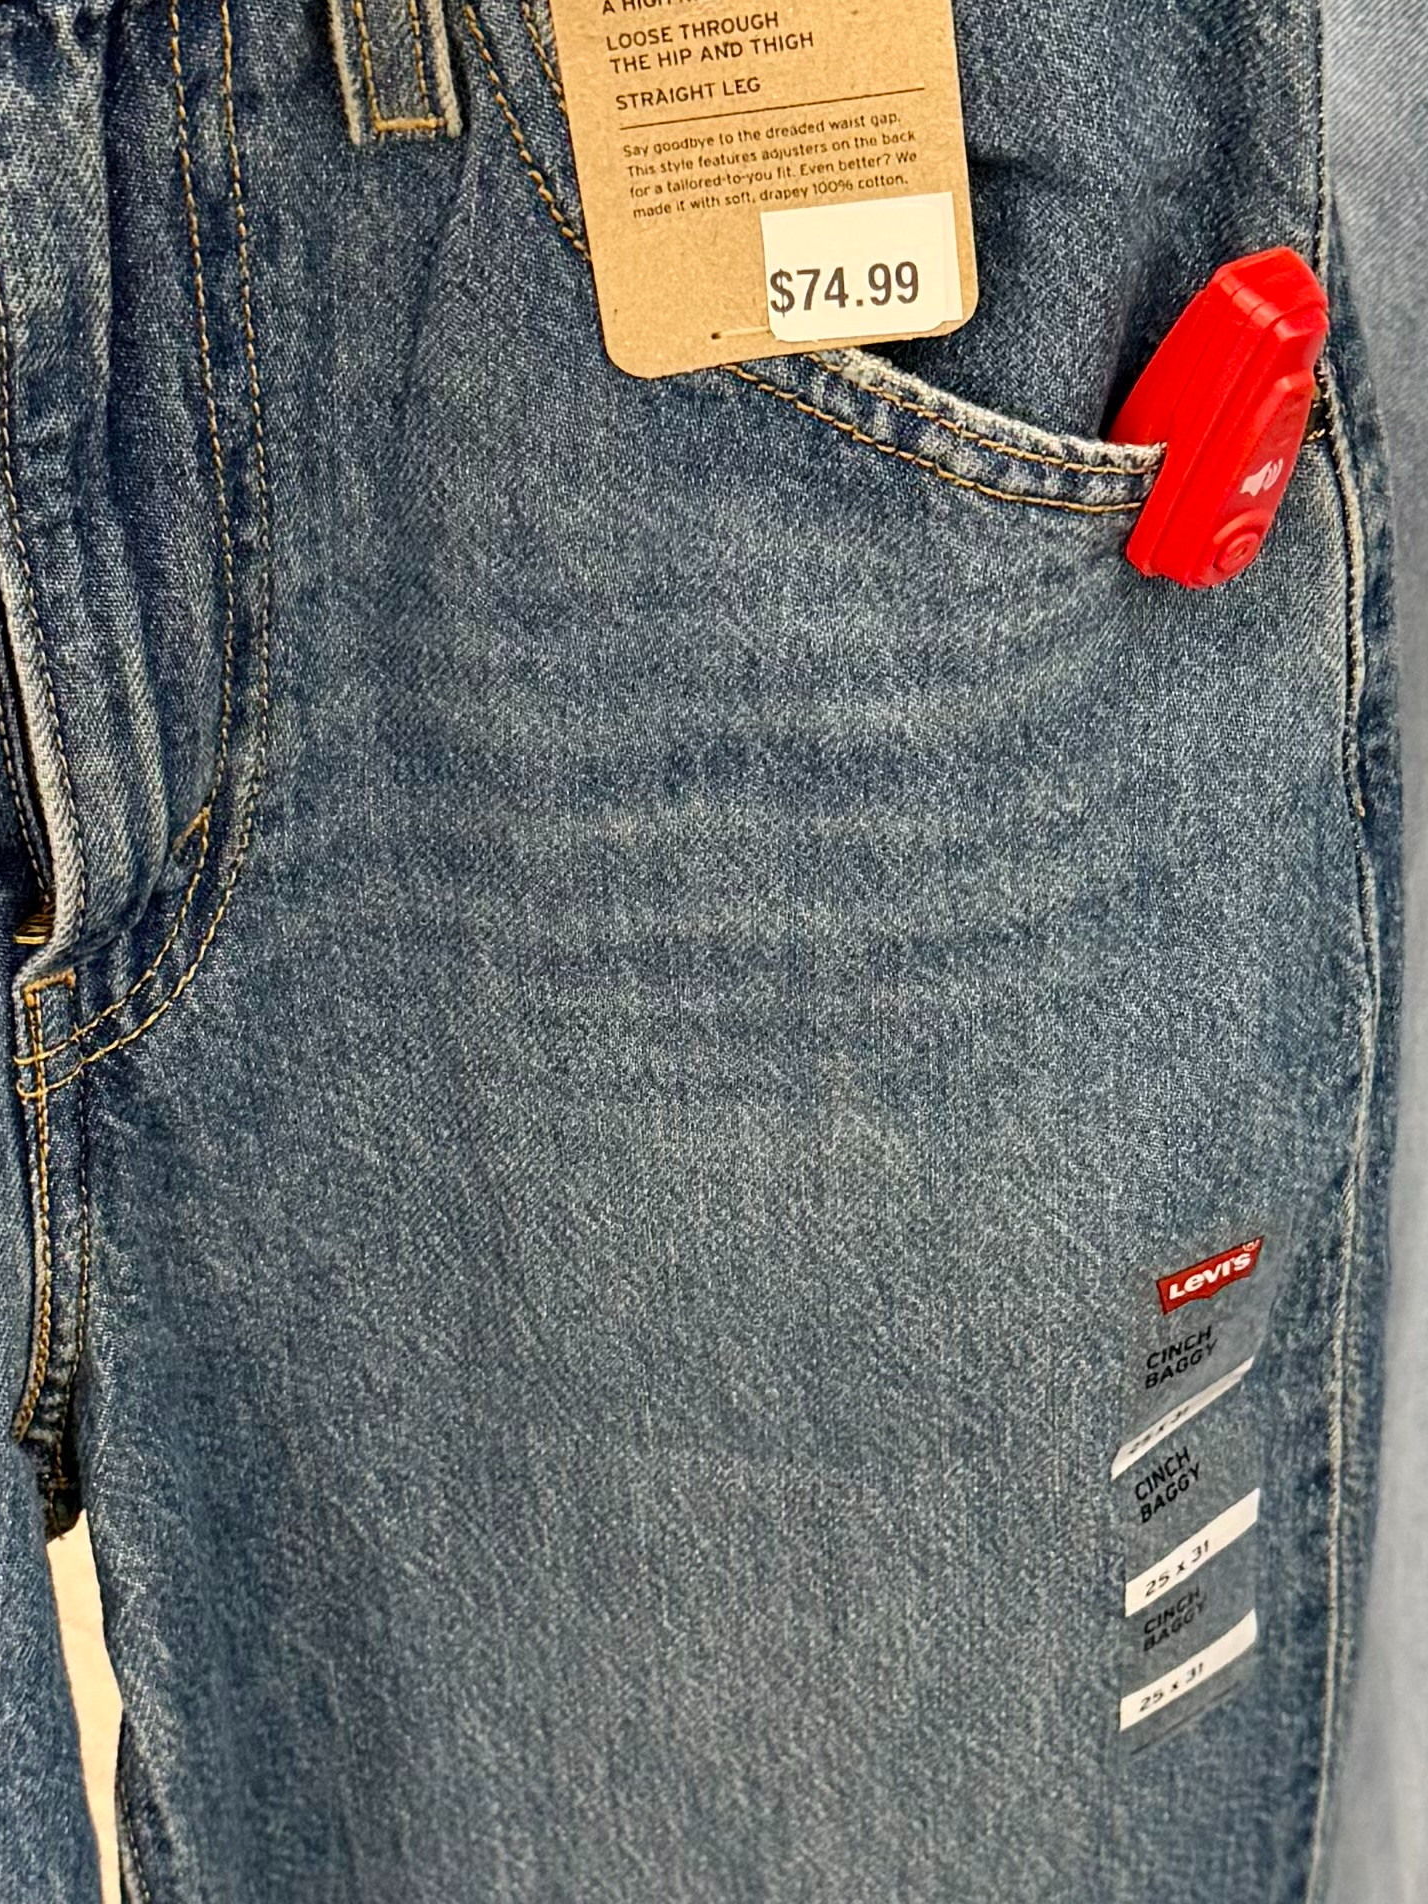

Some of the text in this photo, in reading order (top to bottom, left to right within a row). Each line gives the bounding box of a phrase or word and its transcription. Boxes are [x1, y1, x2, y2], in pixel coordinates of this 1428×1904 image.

[602, 0, 616, 15] A
[605, 11, 779, 51] LOOSE THROUGH
[609, 31, 814, 74] THE HIP AND THIGH
[615, 76, 761, 110] STRAIGHT LEG
[622, 143, 649, 159] Say
[653, 135, 715, 156] goodbye
[719, 132, 733, 146] to
[738, 128, 762, 143] the
[766, 120, 825, 140] dreaded
[828, 114, 866, 132] waist
[627, 130, 917, 178] This style features adjusters on the back
[629, 150, 918, 200] for a tailored-to-you fit. Even better? We
[633, 172, 909, 220] made it with soft, drapey 100% cotton.
[770, 261, 919, 318] $74.99
[1145, 1338, 1218, 1390] BAGGY
[1146, 1325, 1212, 1370] CINCH
[1134, 1446, 1191, 1501] CINCH
[1140, 1461, 1200, 1524] BAGGY
[1144, 1570, 1170, 1598] 25
[1191, 1539, 1210, 1564] 31
[1142, 1594, 1208, 1653] BAGGY
[1143, 1586, 1200, 1635] CINCH
[1139, 1688, 1165, 1713] 25
[1185, 1662, 1204, 1684] 31
